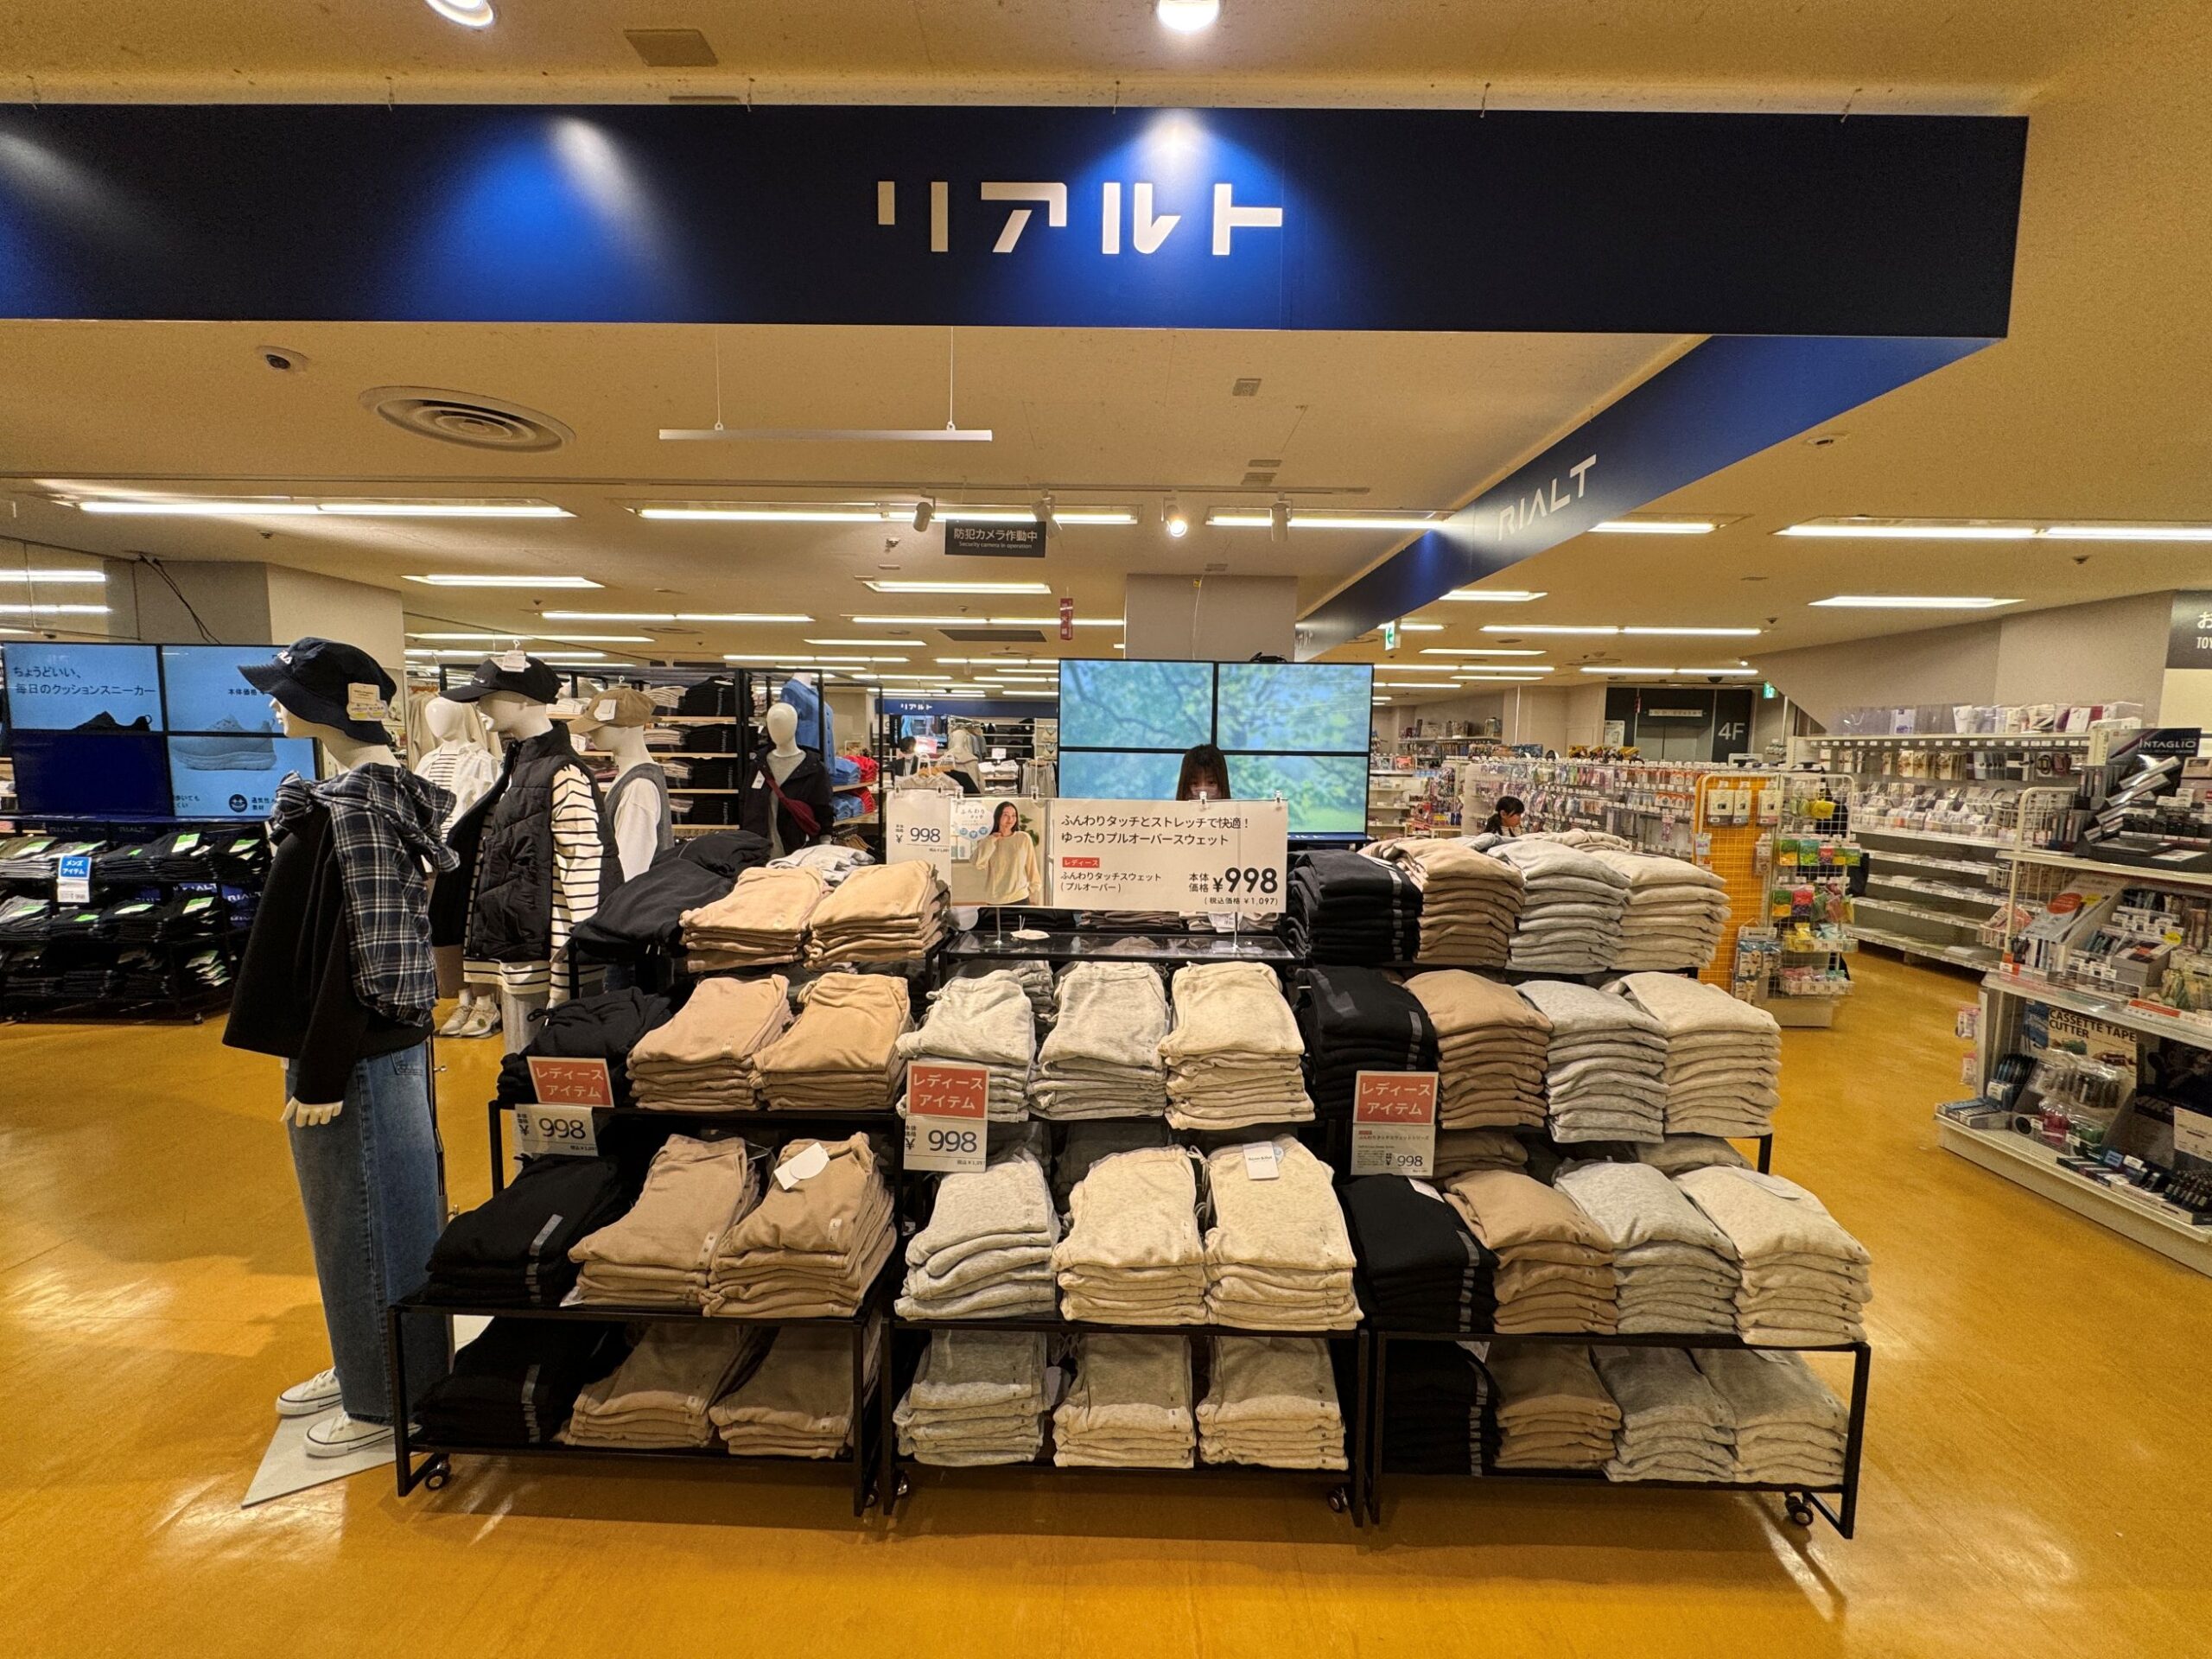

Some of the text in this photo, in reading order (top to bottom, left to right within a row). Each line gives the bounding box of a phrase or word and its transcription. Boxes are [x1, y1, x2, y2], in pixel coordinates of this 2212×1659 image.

[877, 181, 1283, 256] リアルト
[1498, 453, 1597, 543] RIALT
[954, 528, 1037, 542] 防犯カメラ作動中
[13, 666, 81, 679] ちょうどいい、
[16, 683, 156, 696] 毎日のクッションスニーカー
[1718, 722, 1745, 741] 4F
[2139, 738, 2196, 749] INTAGLIO
[910, 827, 941, 843] 998
[1061, 831, 1229, 846] ゆったりプルオーバースウェット
[1060, 871, 1162, 882] ふんわりタッチスウェット
[1188, 872, 1210, 882] 本体
[1188, 882, 1210, 893] 価格
[2049, 1009, 2104, 1033] CASSETTE
[2105, 1025, 2137, 1043] TAPE
[2049, 1020, 2089, 1039] CUTTER
[536, 1067, 604, 1081] レディース
[913, 1073, 983, 1090] レディース
[545, 1084, 601, 1099] アイテム
[1362, 1082, 1432, 1096] レディース
[918, 1093, 976, 1110] アイテム
[1367, 1103, 1423, 1116] アイテム
[538, 1117, 586, 1140] 998
[928, 1129, 978, 1154] 998
[1397, 1154, 1424, 1167] 998
